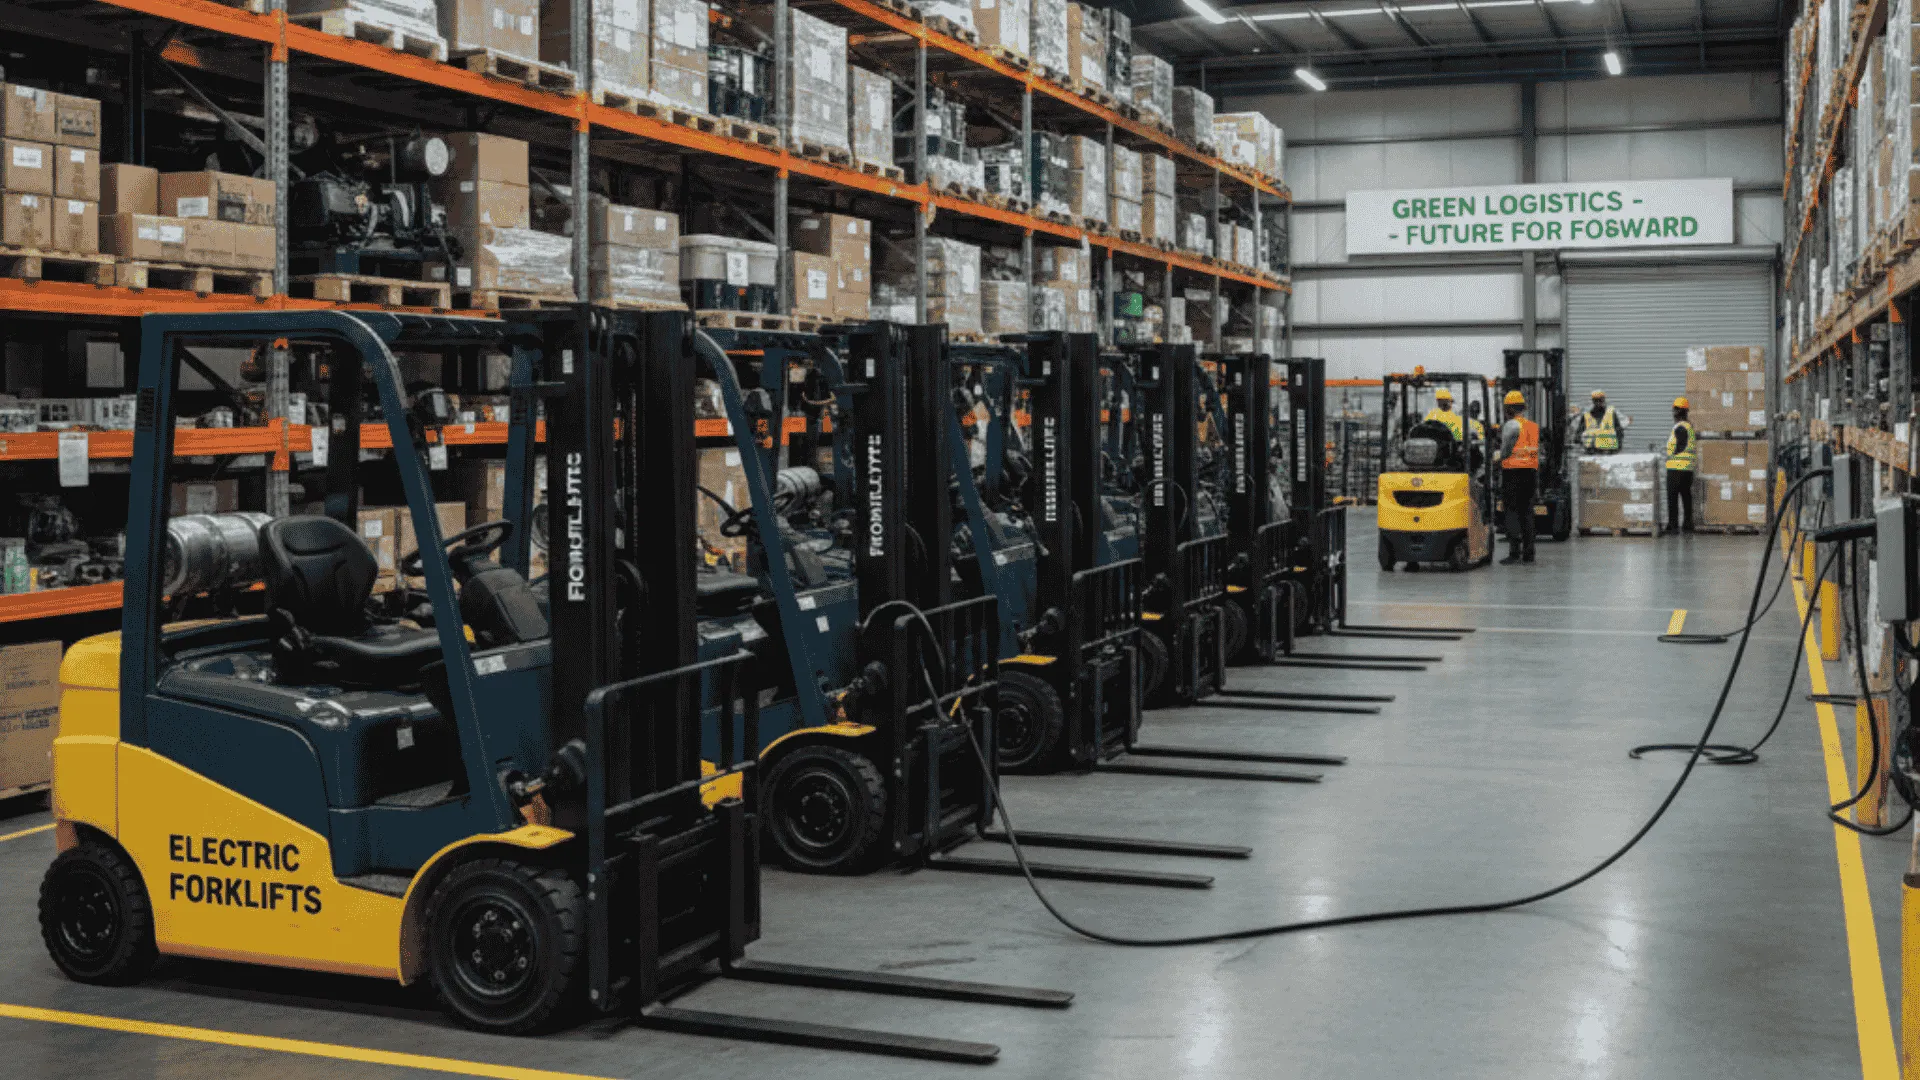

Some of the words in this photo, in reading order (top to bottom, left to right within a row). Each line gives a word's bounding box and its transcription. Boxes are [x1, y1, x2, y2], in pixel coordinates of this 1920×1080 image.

[1392, 195, 1475, 220] GREEN
[1484, 191, 1623, 216] LOGISTICS
[1406, 223, 1505, 246] FUTURE
[1511, 220, 1562, 241] FOR
[169, 833, 300, 872] ELECTRIC
[170, 872, 322, 915] FORKLIFTS
